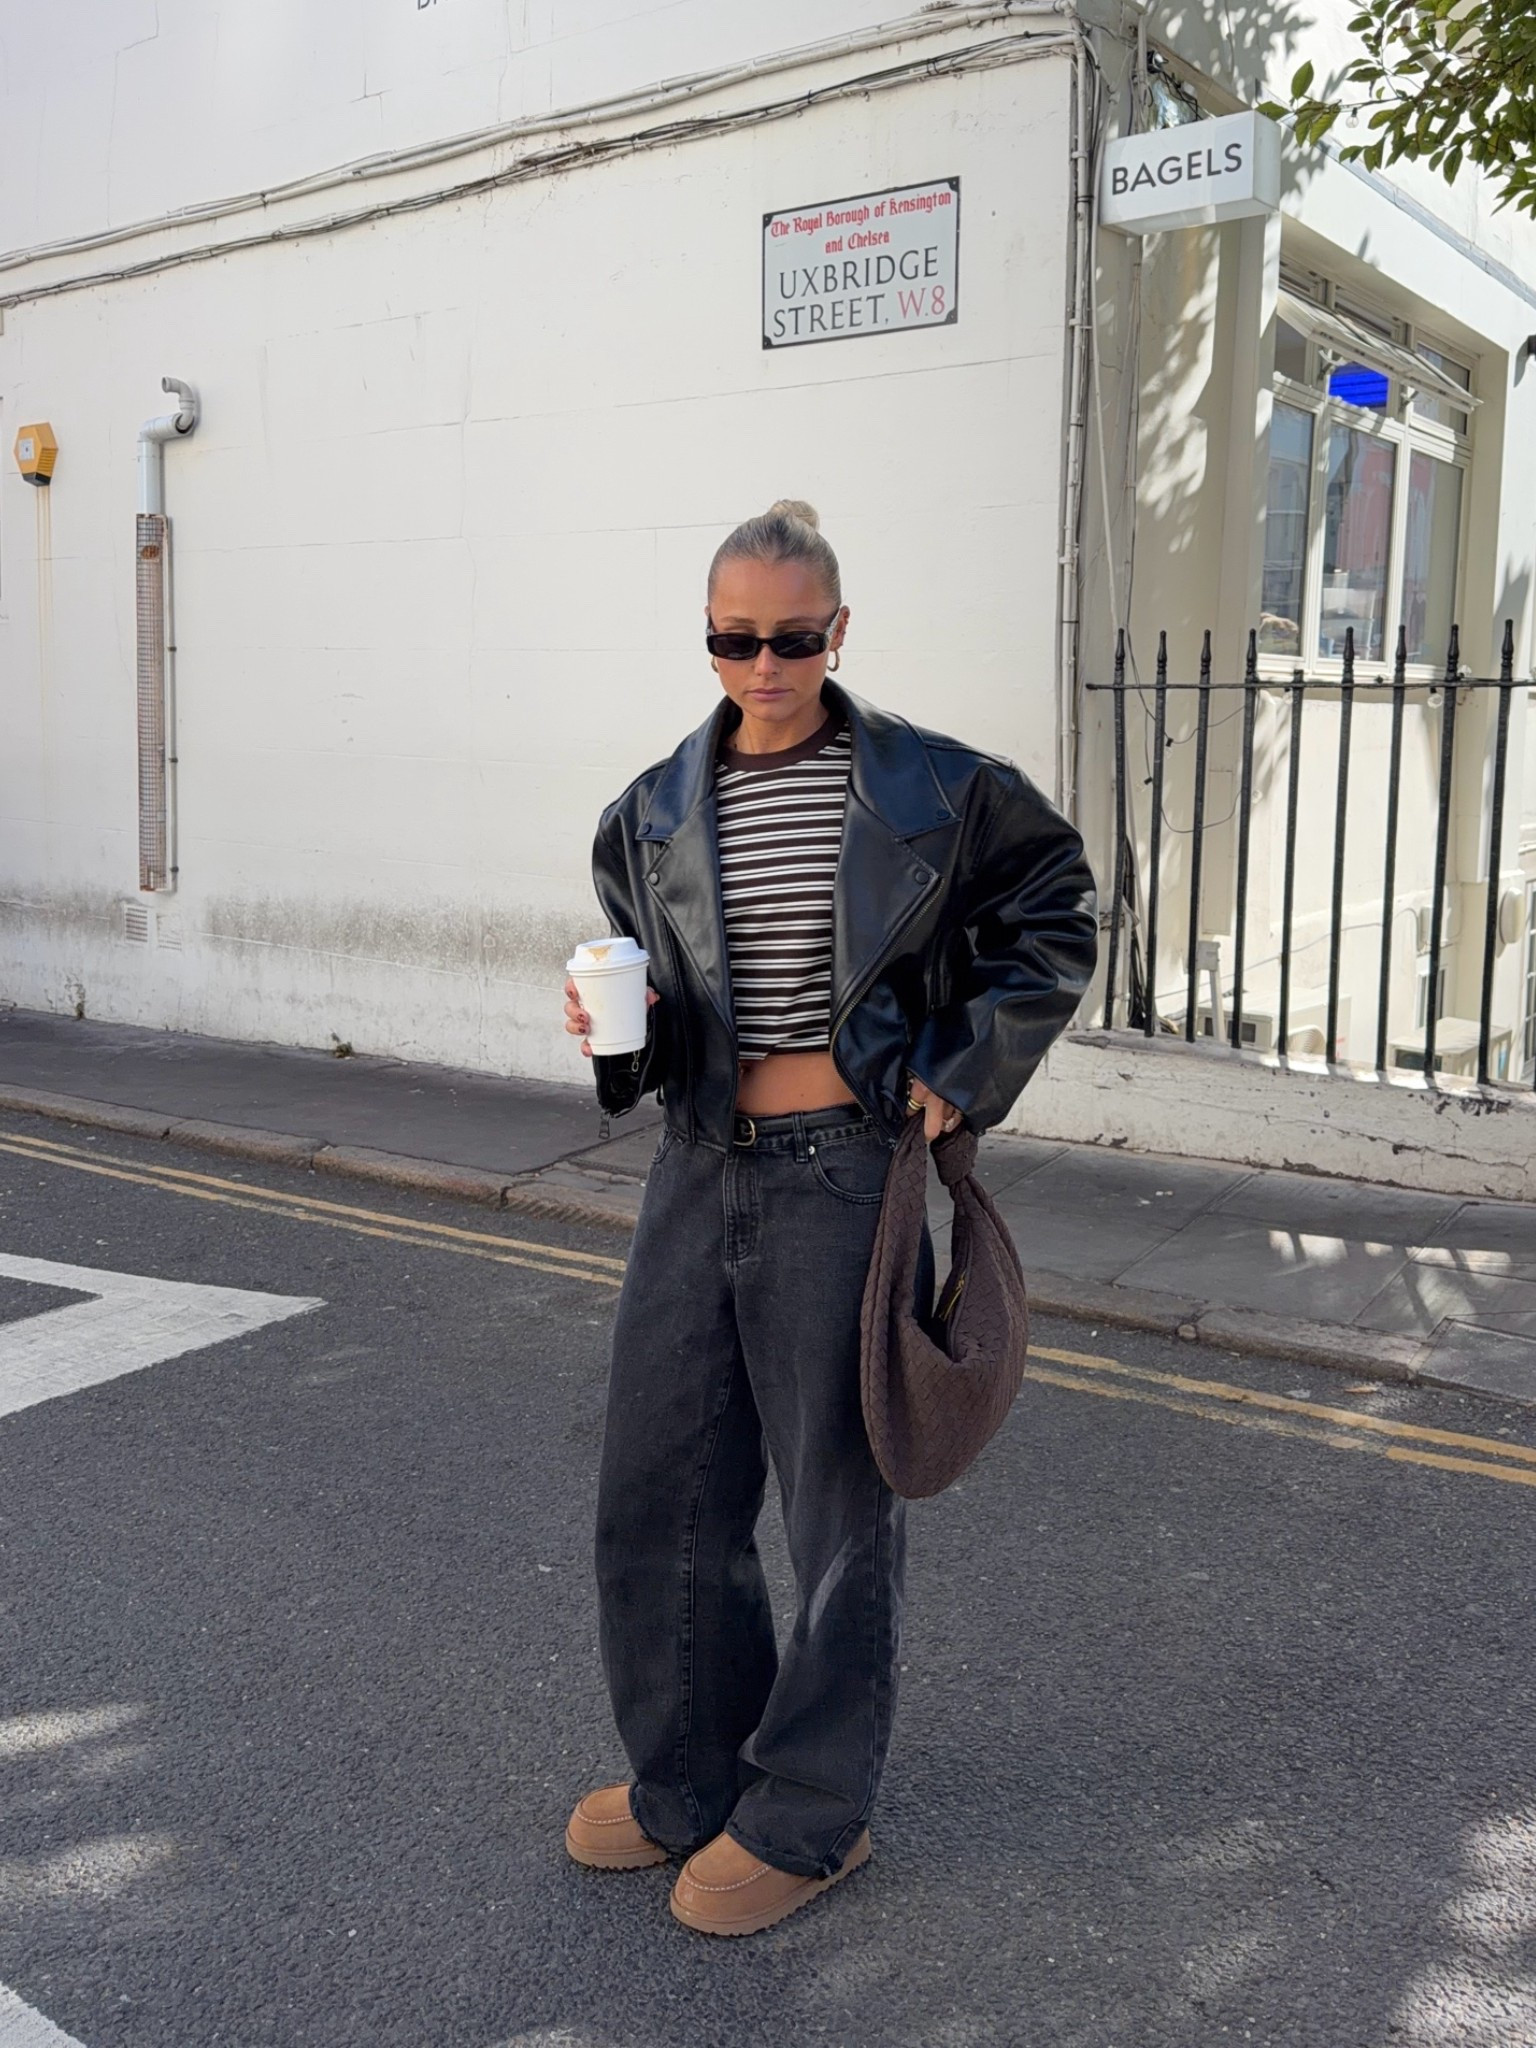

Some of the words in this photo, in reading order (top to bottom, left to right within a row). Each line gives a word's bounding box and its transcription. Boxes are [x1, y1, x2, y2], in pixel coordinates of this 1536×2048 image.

[1112, 143, 1242, 195] BAGELS
[771, 221, 791, 238] The
[793, 213, 823, 236] Royal
[826, 205, 870, 227] Borough
[874, 201, 887, 218] of
[889, 191, 952, 216] Kensington
[825, 235, 843, 254] and
[848, 230, 890, 250] Chelsea
[779, 245, 939, 300] UXBRIDGE
[773, 293, 889, 338] STREET,
[897, 285, 945, 319] W.8
